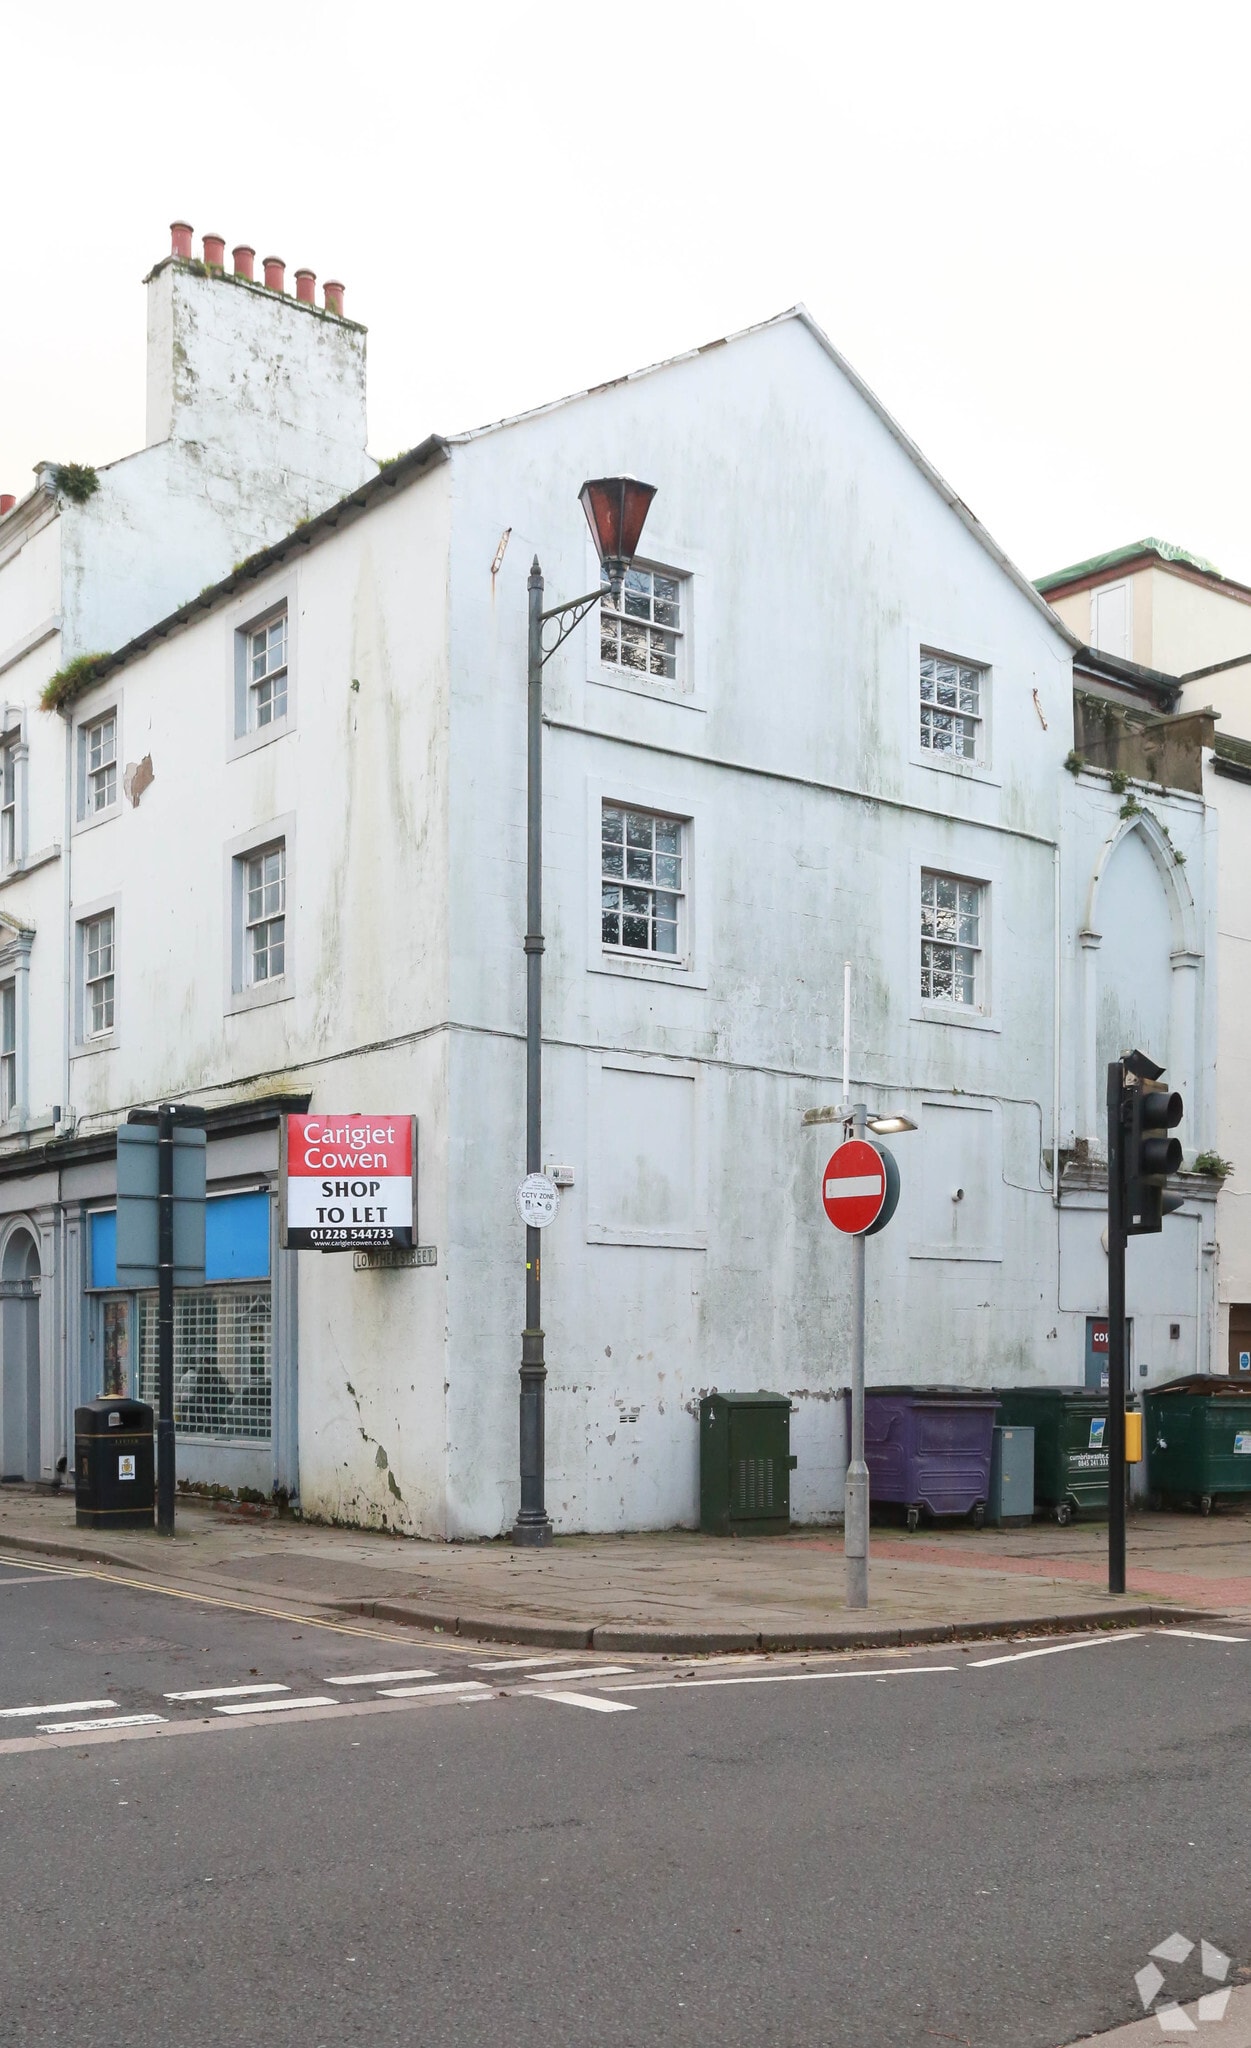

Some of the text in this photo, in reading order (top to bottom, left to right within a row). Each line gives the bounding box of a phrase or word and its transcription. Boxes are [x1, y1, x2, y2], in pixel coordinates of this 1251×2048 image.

[303, 1123, 396, 1150] Carigiet
[304, 1148, 388, 1169] Cowen
[321, 1181, 381, 1198] SHOP
[521, 1191, 538, 1199] CCTV
[316, 1207, 388, 1224] TO LET
[310, 1228, 394, 1240] 01228 544733
[314, 1239, 390, 1248] www.carigietcowen.co.uk
[356, 1249, 433, 1267] LOWTHER STREET
[1093, 1332, 1109, 1343] COS
[1069, 1453, 1109, 1461] cumbriawaste.c
[1100, 1458, 1109, 1466] 333
